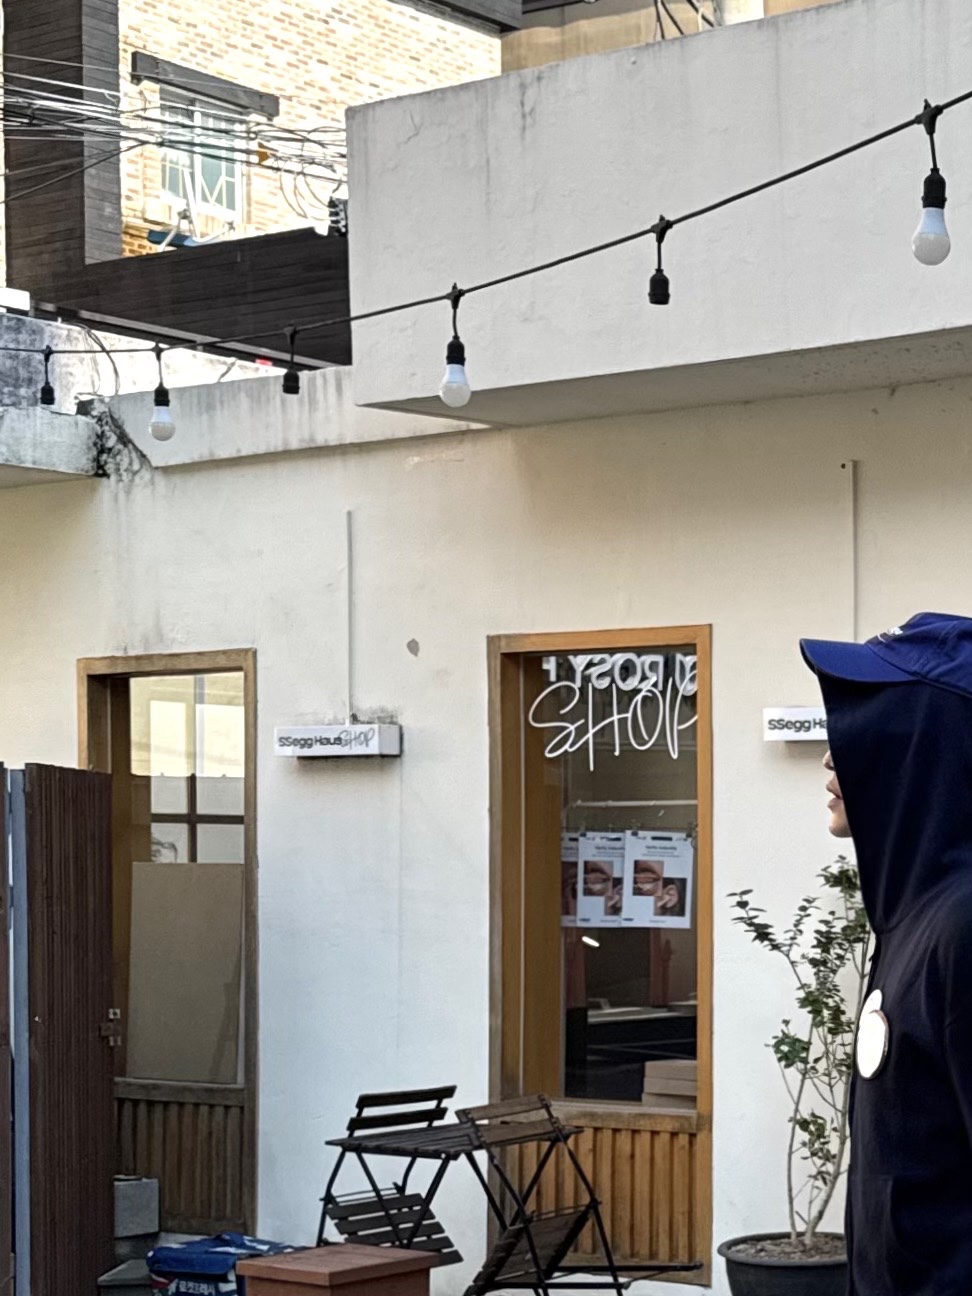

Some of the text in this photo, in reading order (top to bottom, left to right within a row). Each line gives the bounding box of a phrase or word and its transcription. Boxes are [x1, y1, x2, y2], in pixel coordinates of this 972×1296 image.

[768, 718, 812, 733] SSegg
[278, 728, 376, 749] SSegg Haus SHOP
